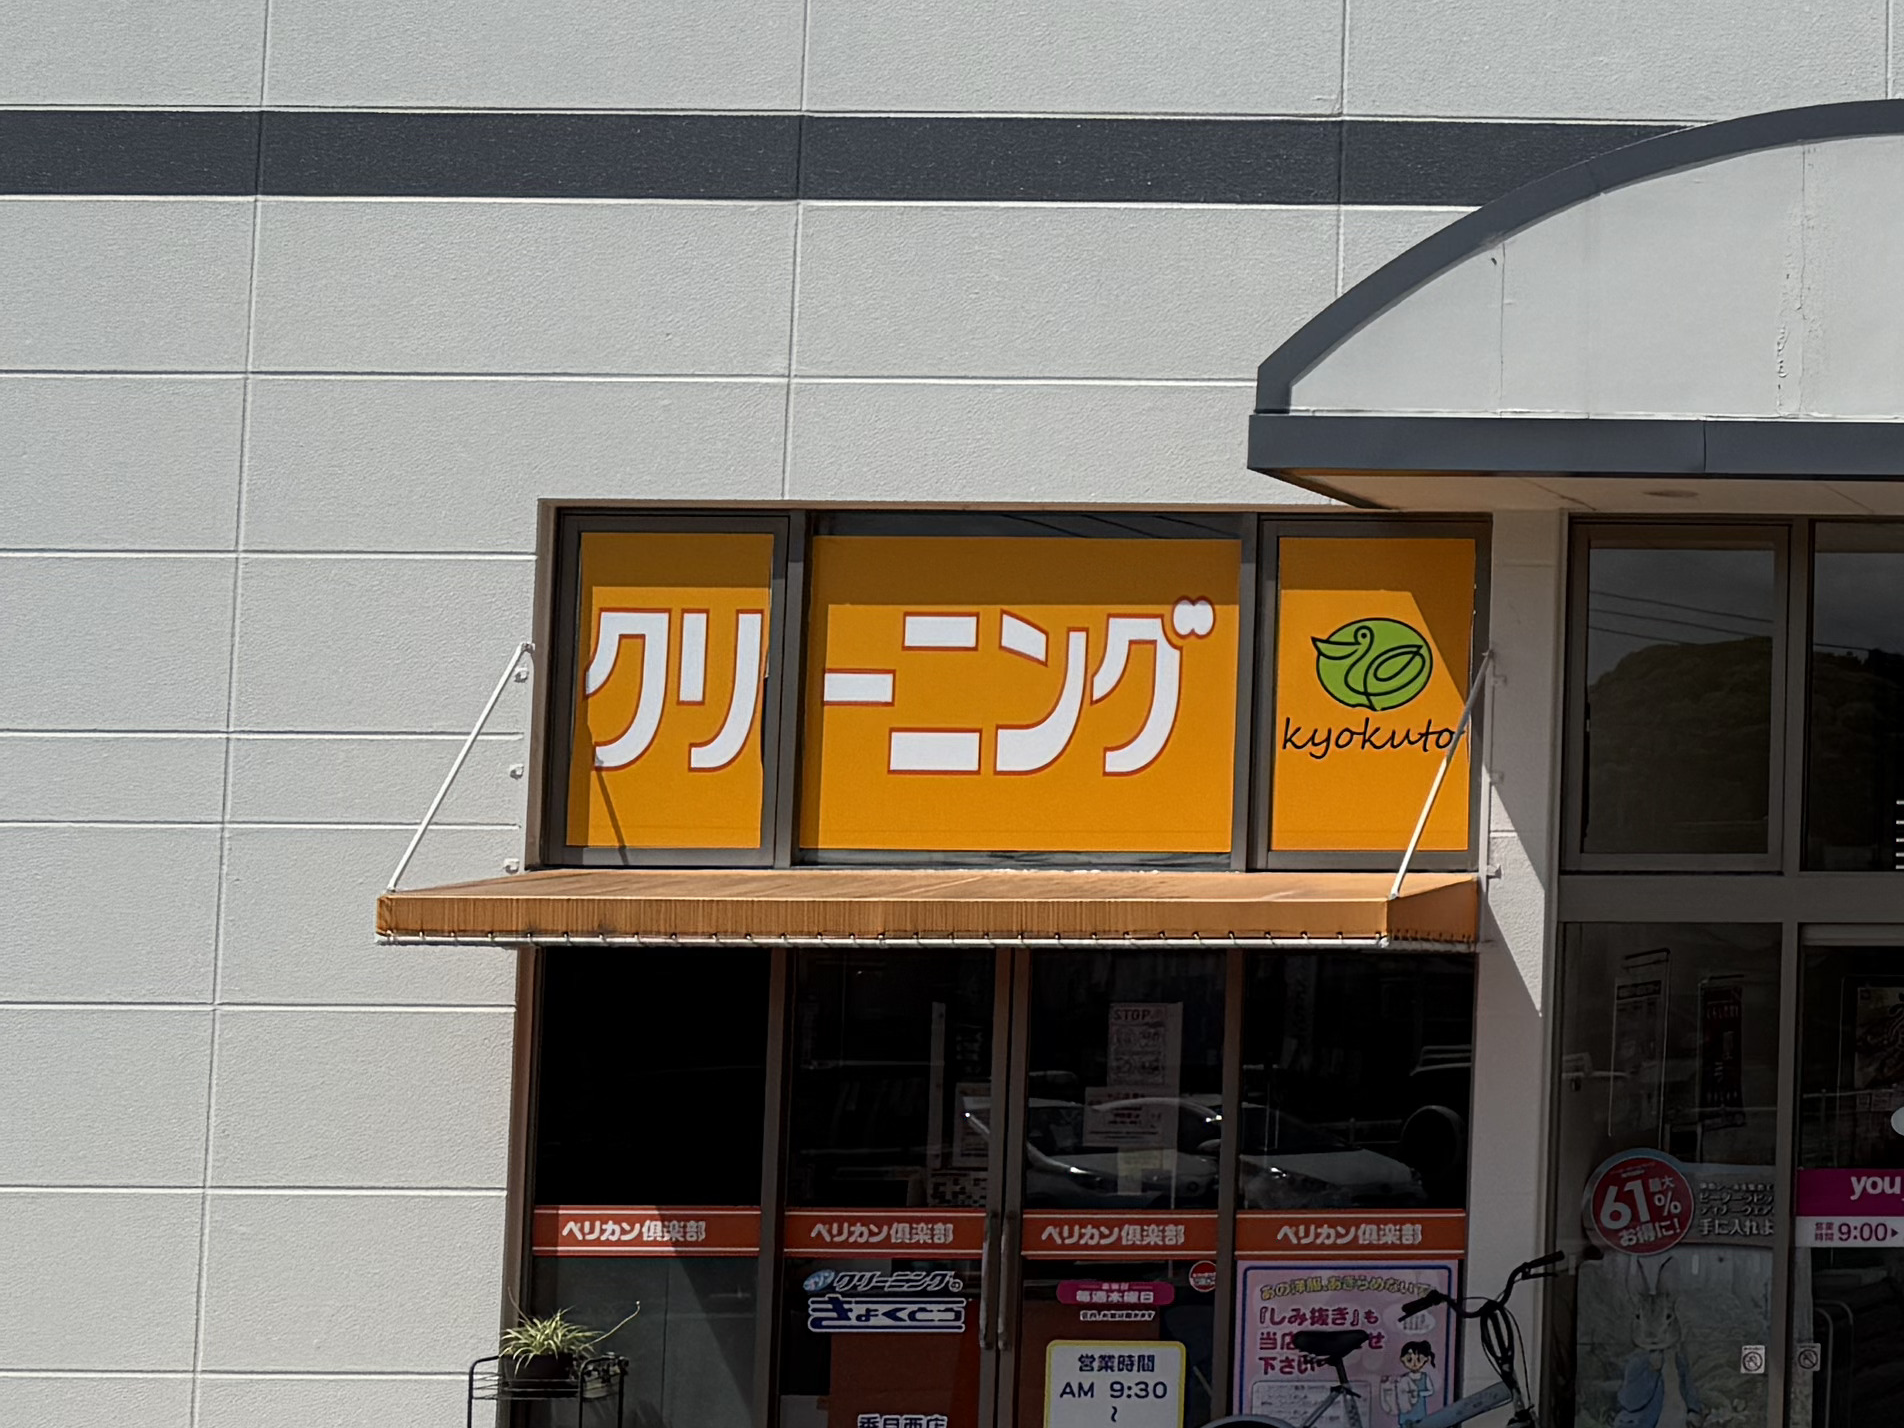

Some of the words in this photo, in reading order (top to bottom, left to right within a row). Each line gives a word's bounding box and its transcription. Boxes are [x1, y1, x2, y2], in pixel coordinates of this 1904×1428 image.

[584, 595, 1216, 777] クリーニング
[1281, 717, 1463, 760] kyokuto
[1838, 1223, 1888, 1241] 9:00
[808, 1294, 966, 1333] きょくとう
[1078, 1354, 1156, 1372] 営業時間
[1059, 1381, 1095, 1398] AM
[1109, 1381, 1168, 1399] 9:30
